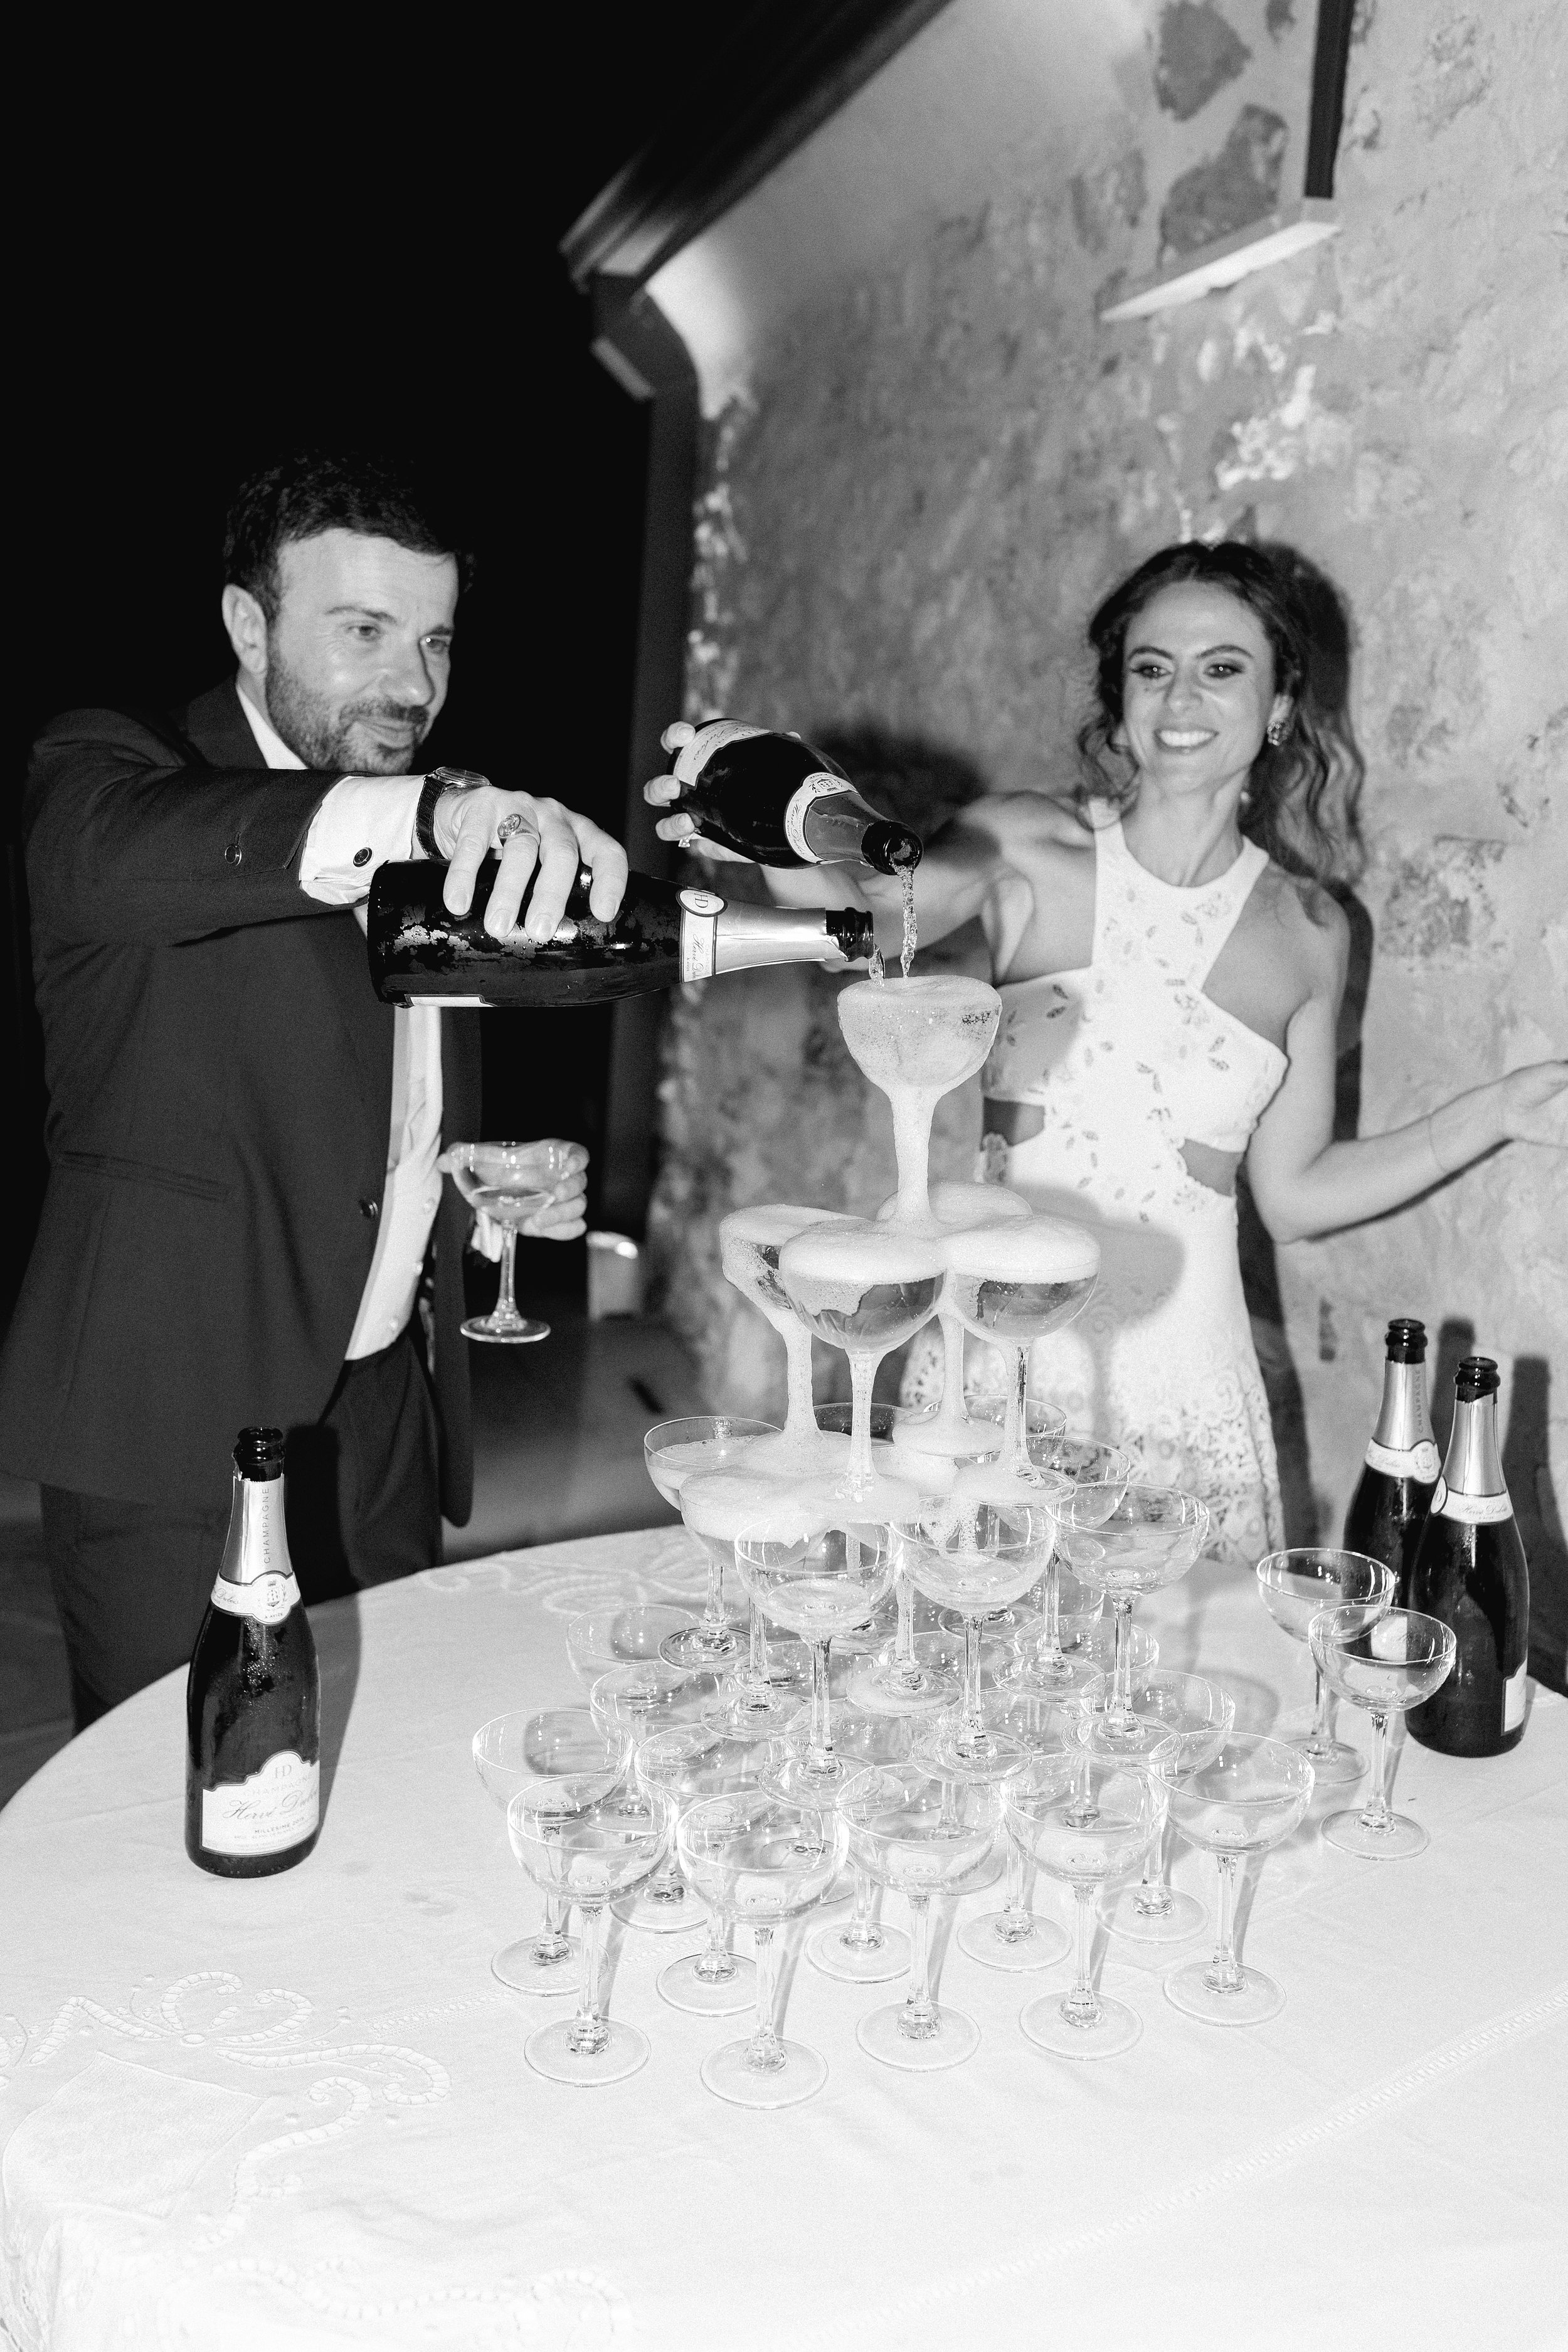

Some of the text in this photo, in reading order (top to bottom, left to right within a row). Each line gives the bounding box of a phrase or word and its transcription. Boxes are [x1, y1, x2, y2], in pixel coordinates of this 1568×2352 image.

[694, 893, 709, 908] HD
[692, 934, 705, 961] Hervé
[1416, 1370, 1424, 1434] CHAMPAGNE
[262, 1488, 270, 1564] CHAMPAGNE
[274, 1764, 292, 1779] HD
